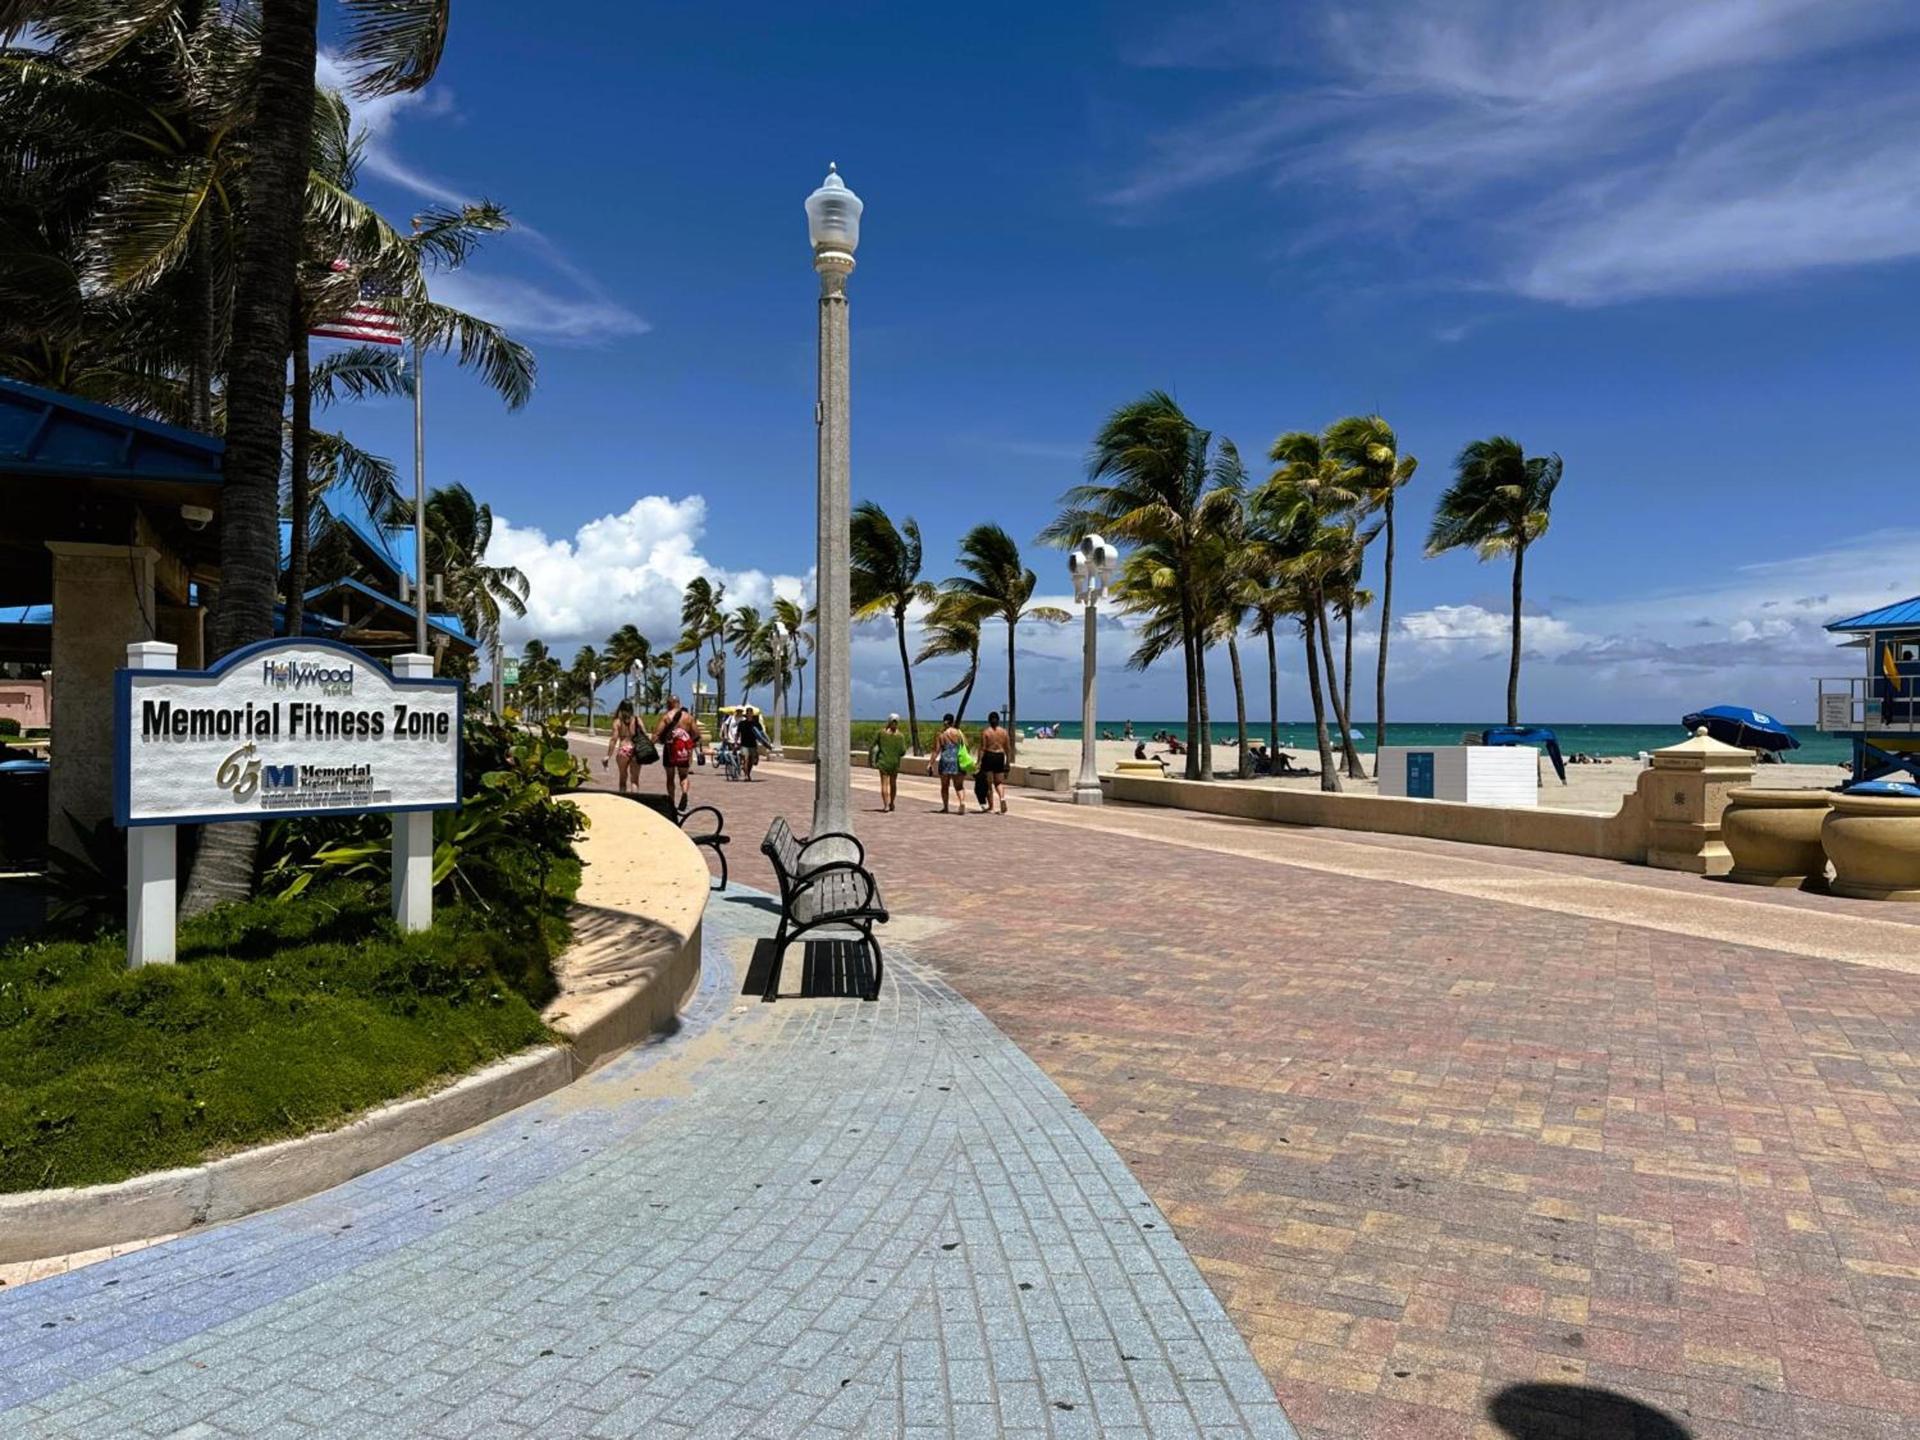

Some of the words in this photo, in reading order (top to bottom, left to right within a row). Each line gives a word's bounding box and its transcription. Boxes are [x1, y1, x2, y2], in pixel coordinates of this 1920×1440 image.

[263, 660, 354, 689] Hollywood
[142, 700, 280, 736] Memorial
[289, 703, 385, 736] Fitness
[393, 704, 449, 735] Zone
[216, 742, 262, 798] 65
[300, 764, 371, 777] Memorial
